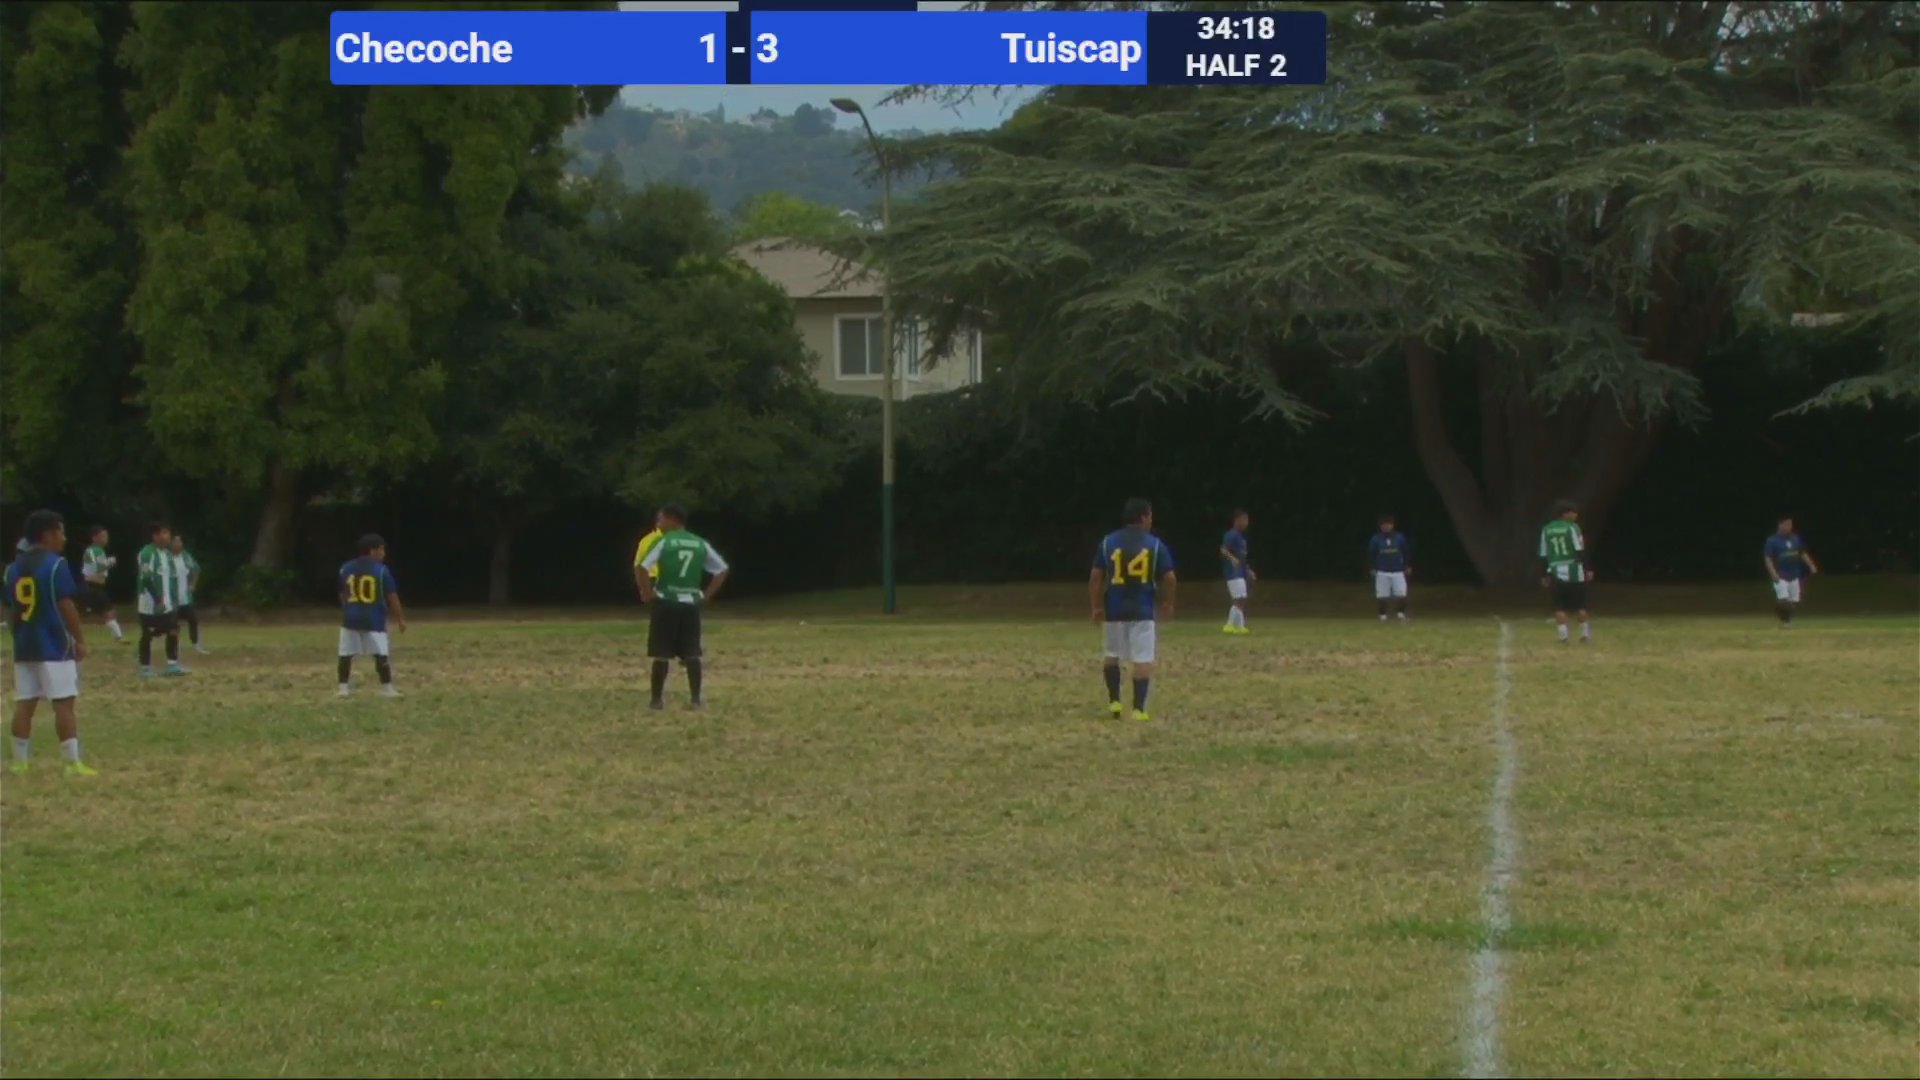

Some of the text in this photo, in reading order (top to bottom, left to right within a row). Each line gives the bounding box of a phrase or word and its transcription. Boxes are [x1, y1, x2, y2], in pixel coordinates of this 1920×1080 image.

[1550, 536, 1569, 555] 11
[678, 550, 694, 578] 7
[1110, 547, 1149, 585] 14
[15, 576, 35, 622] 9
[346, 574, 376, 604] 10
